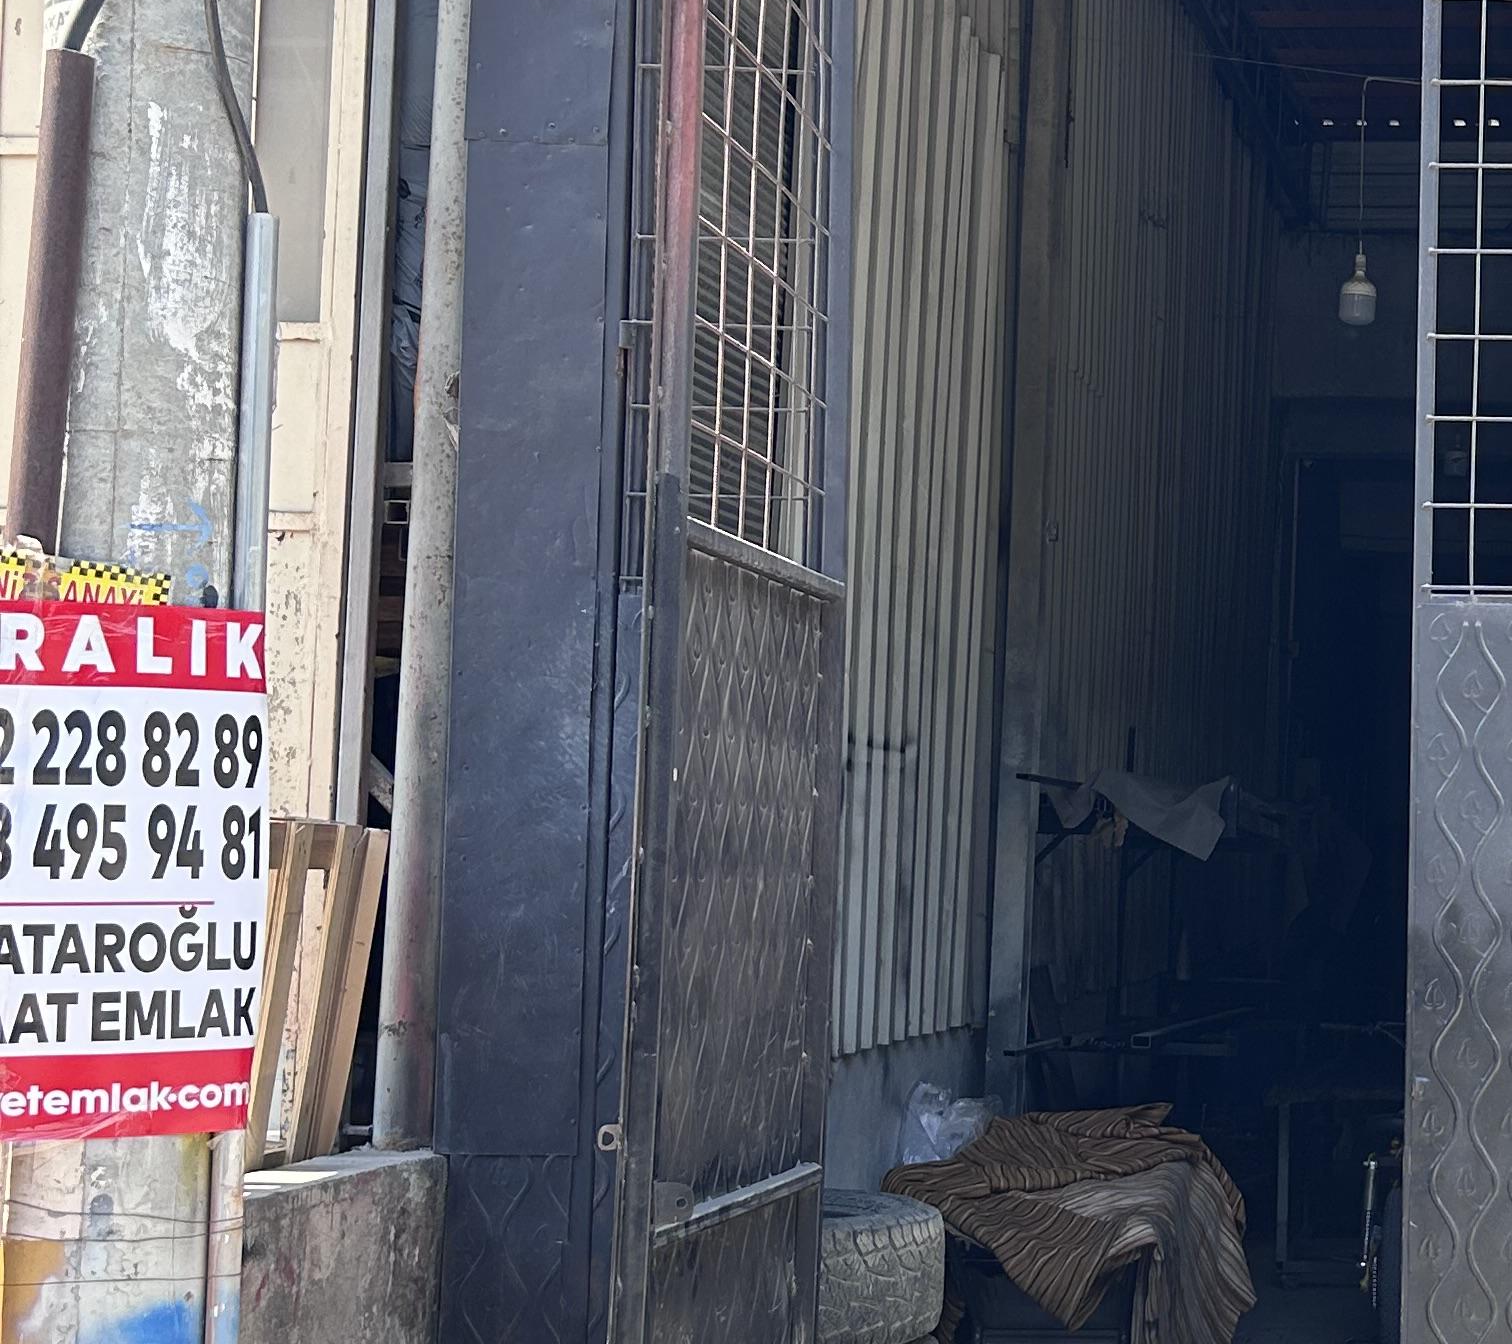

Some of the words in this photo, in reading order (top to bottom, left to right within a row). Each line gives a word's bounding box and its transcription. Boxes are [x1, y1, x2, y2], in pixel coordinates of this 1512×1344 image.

[32, 708, 127, 787] 228
[142, 710, 200, 788] 82
[213, 713, 263, 789] 89
[32, 802, 128, 881] 495
[147, 803, 204, 880] 94
[221, 804, 262, 881] 81
[0, 992, 79, 1044] AT
[90, 987, 256, 1043] EMLAK
